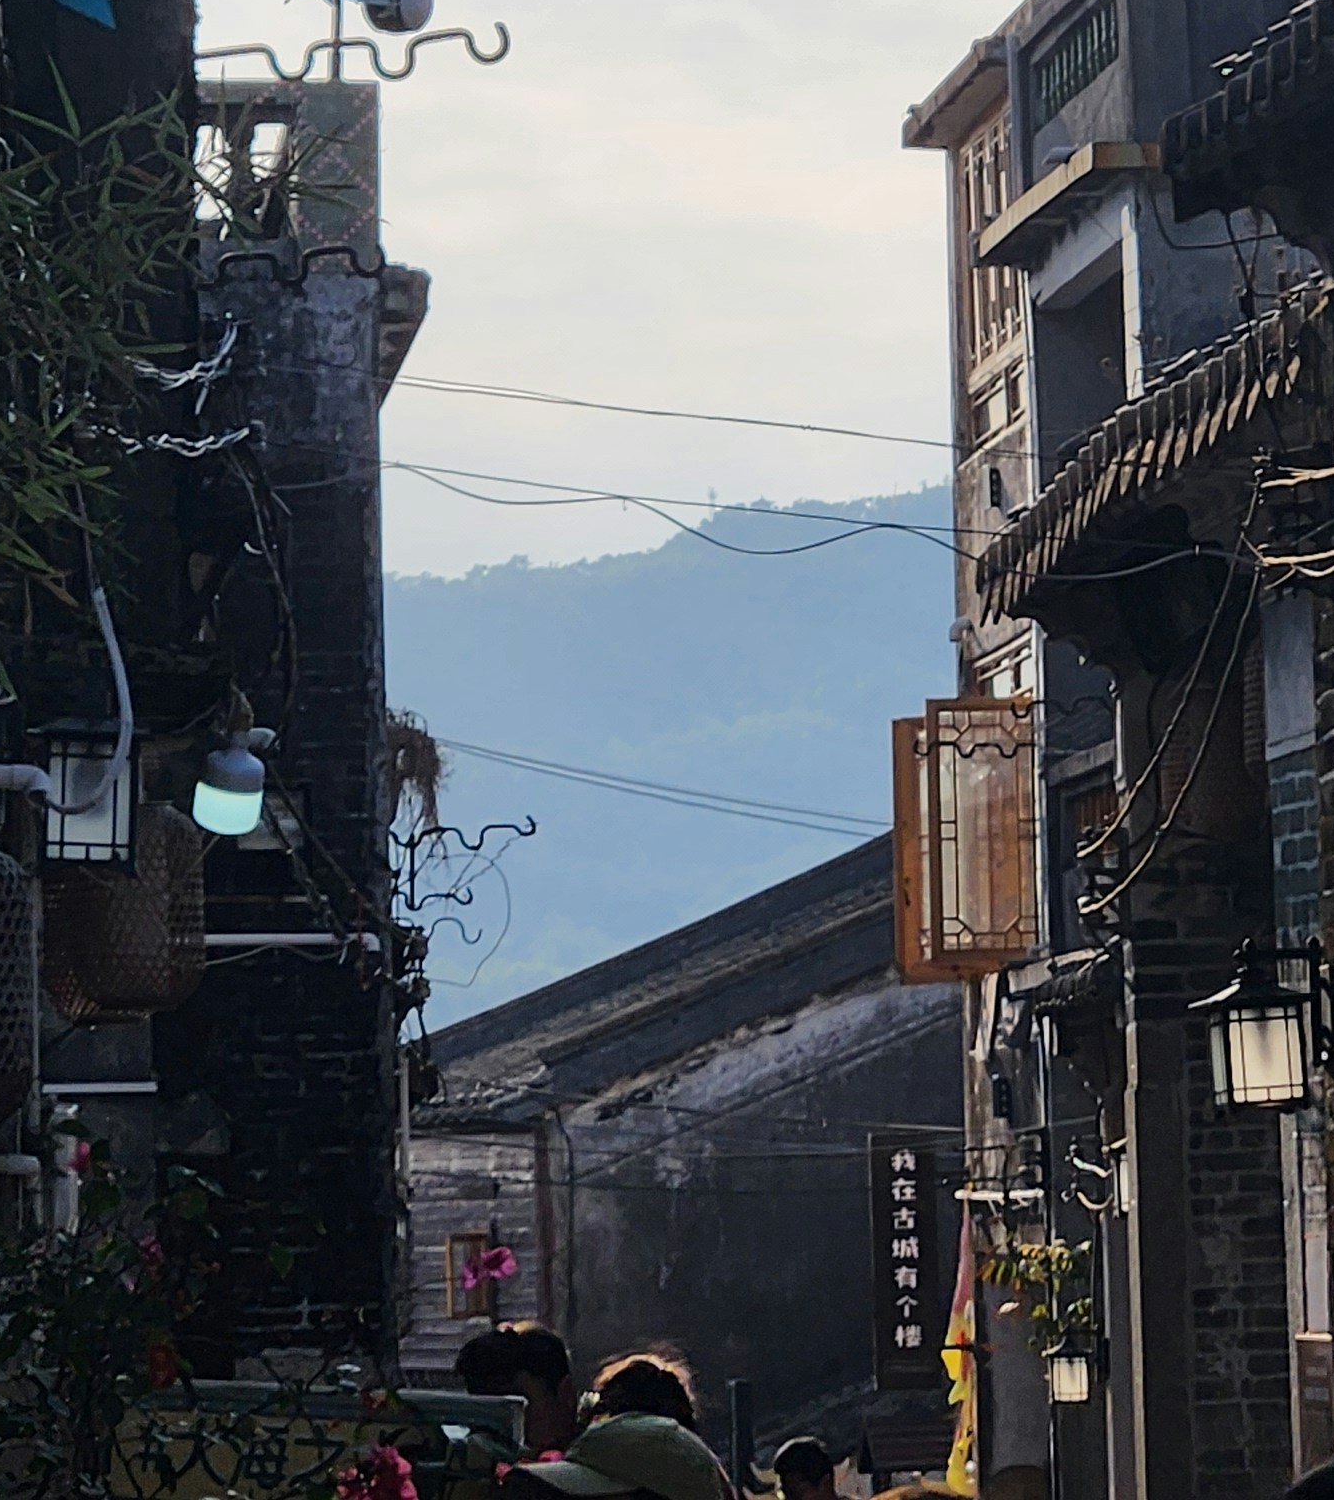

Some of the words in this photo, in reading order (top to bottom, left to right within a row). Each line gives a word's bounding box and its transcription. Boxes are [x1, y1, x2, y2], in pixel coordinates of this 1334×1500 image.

[891, 1149, 923, 1348] 我在古城有个楼
